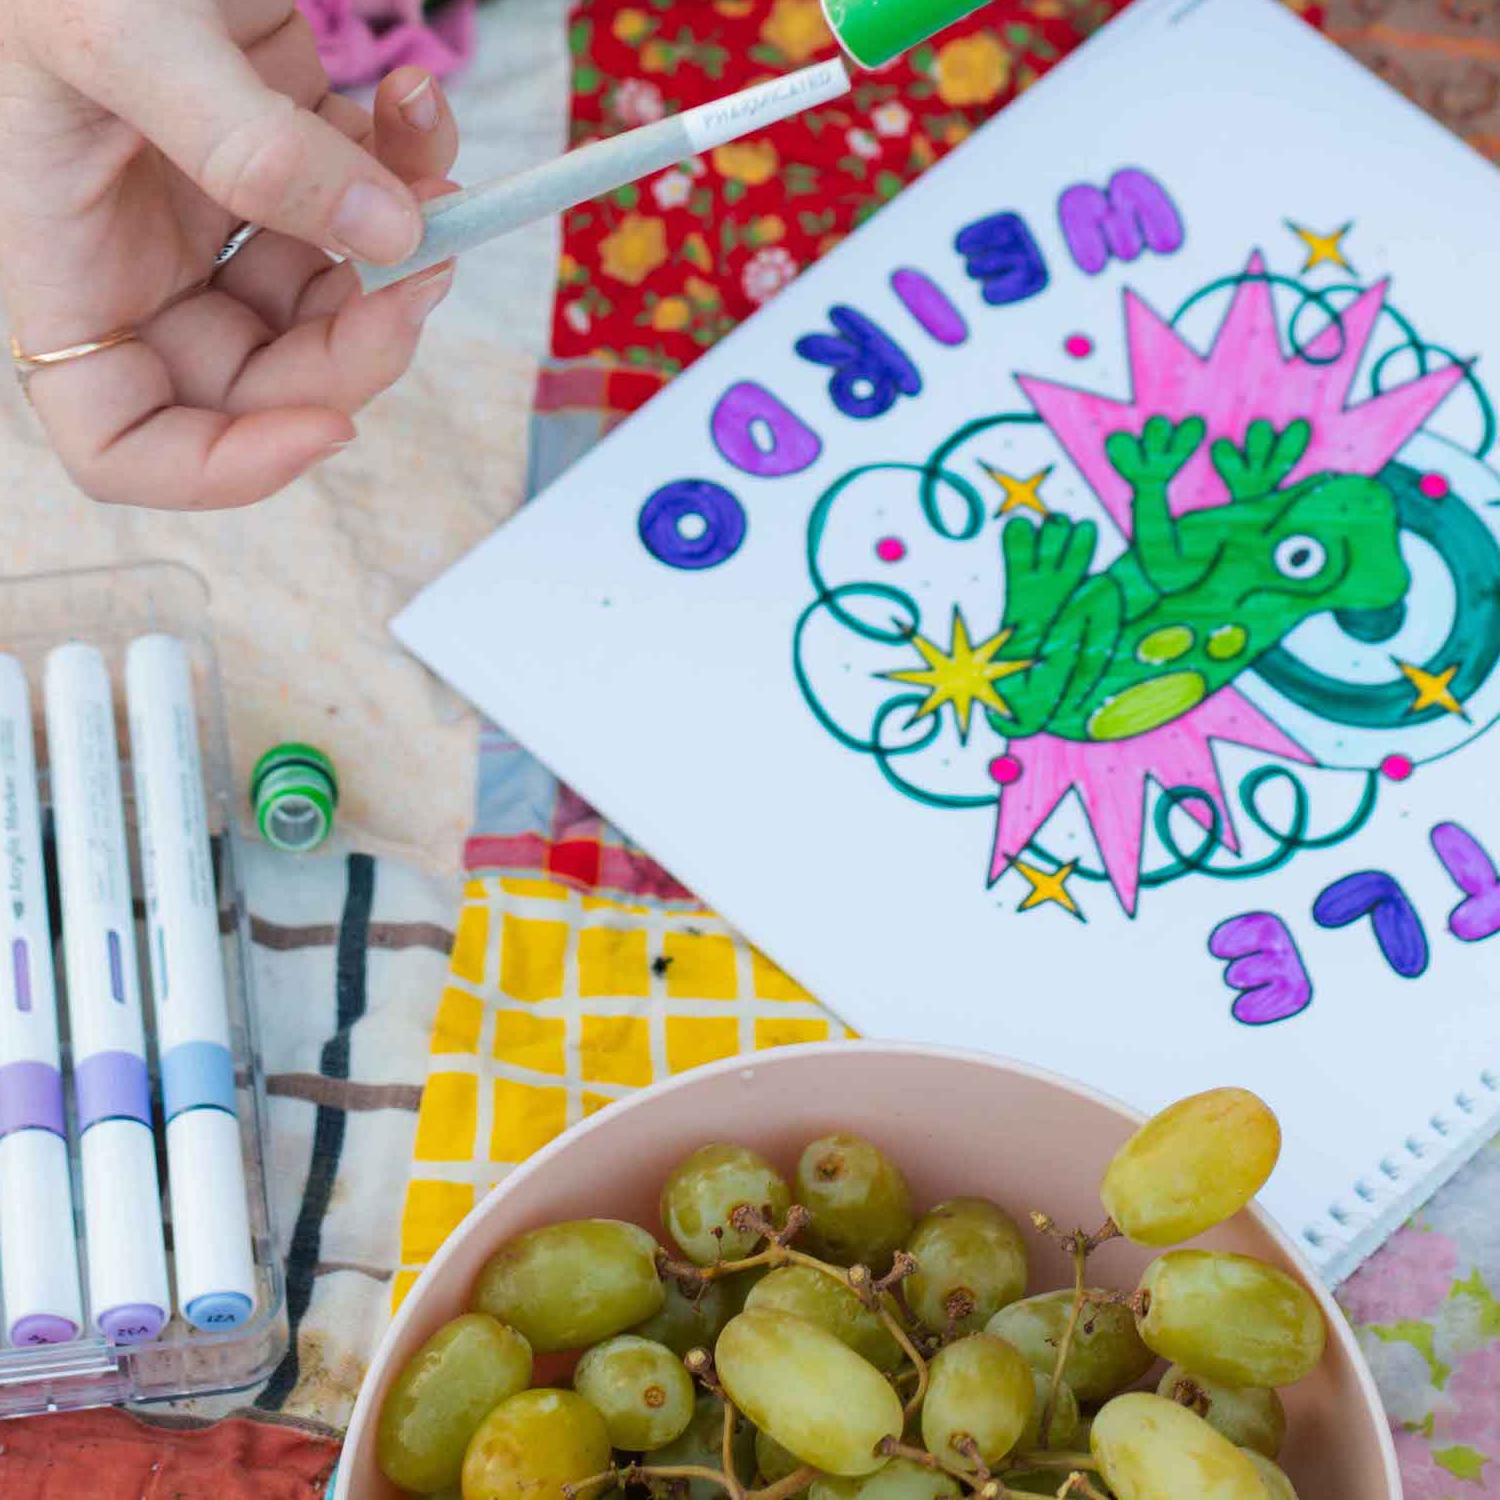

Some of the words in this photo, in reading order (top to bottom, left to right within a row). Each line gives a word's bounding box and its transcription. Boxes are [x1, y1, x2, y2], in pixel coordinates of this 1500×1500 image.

[638, 166, 1185, 571] WEIRDO
[4, 776, 19, 831] Marker
[8, 837, 26, 892] Acrylic
